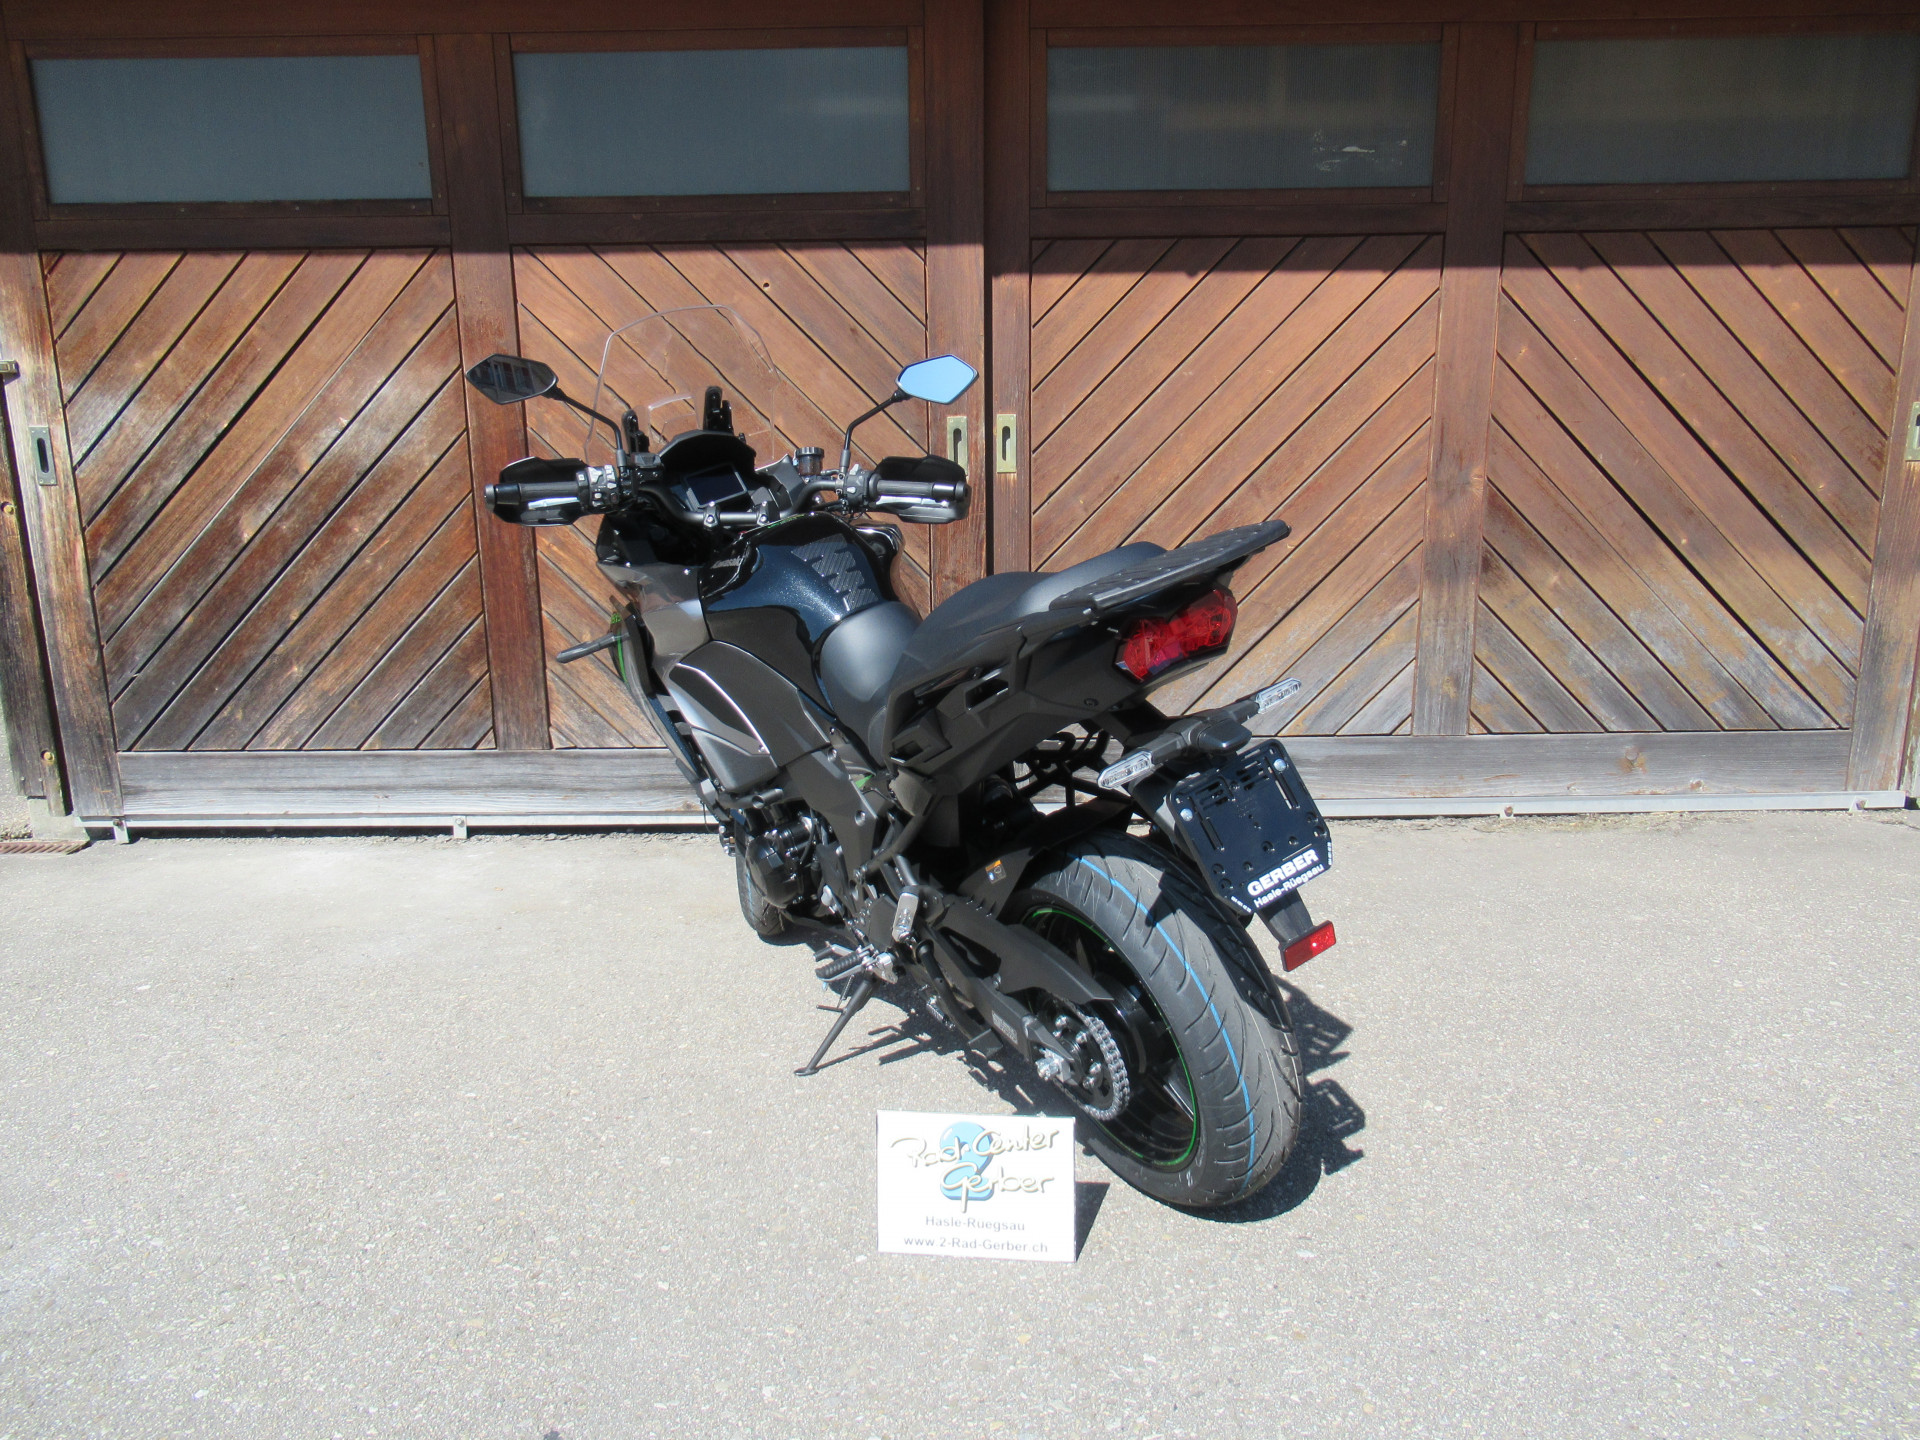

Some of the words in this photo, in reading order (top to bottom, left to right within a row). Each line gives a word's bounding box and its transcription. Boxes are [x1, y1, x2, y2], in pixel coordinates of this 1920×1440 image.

[1247, 849, 1319, 897] GERBER
[1253, 864, 1325, 908] Hasle-Rüegsau
[940, 1162, 1055, 1214] Gerber
[903, 1237, 1049, 1253] www.2-Rad-Gerber.ch
